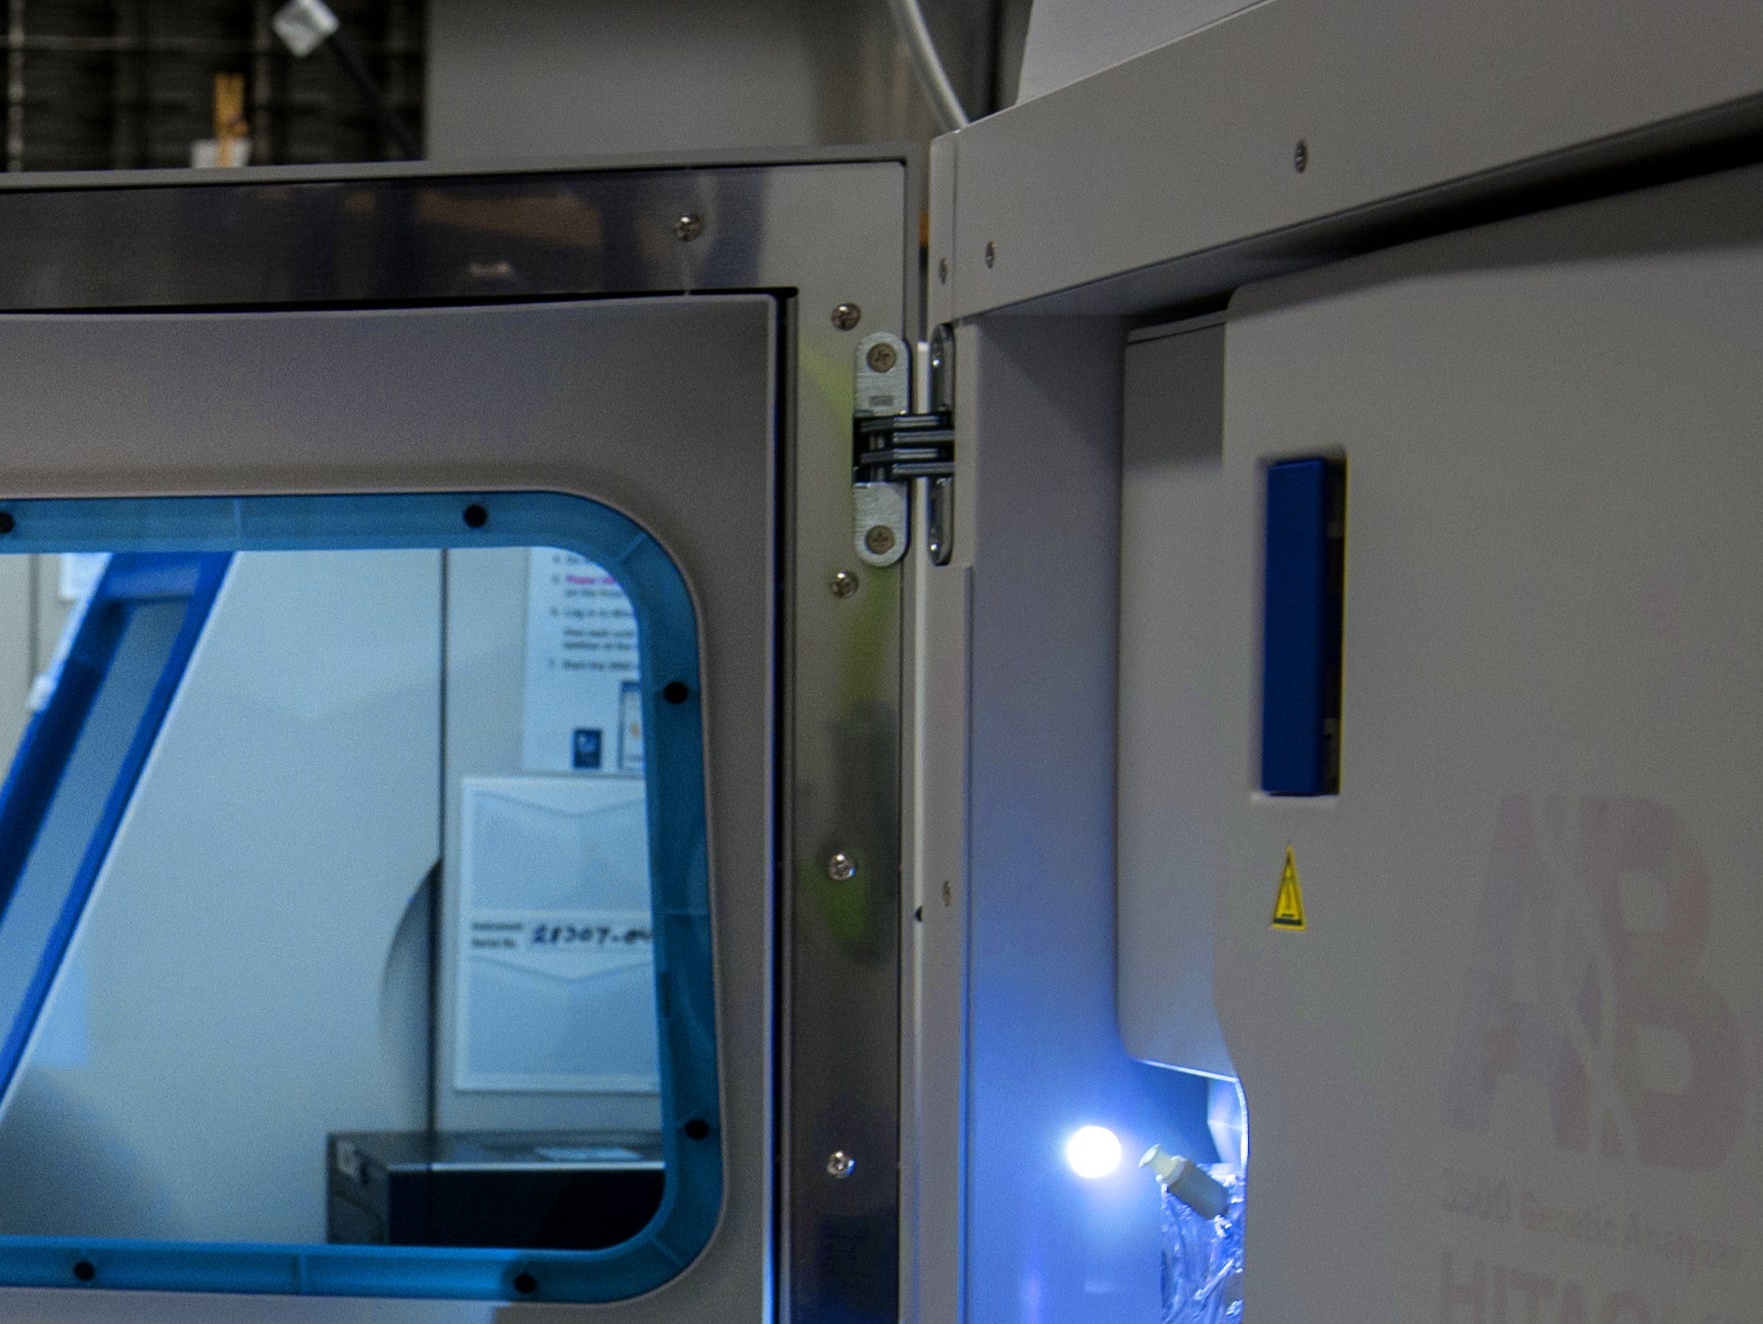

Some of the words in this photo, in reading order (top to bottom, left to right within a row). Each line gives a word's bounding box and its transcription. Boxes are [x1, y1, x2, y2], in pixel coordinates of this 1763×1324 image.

[1443, 794, 1745, 1172] AB
[1519, 1188, 1618, 1248] Genetic
[1622, 1212, 1746, 1276] Analyzer
